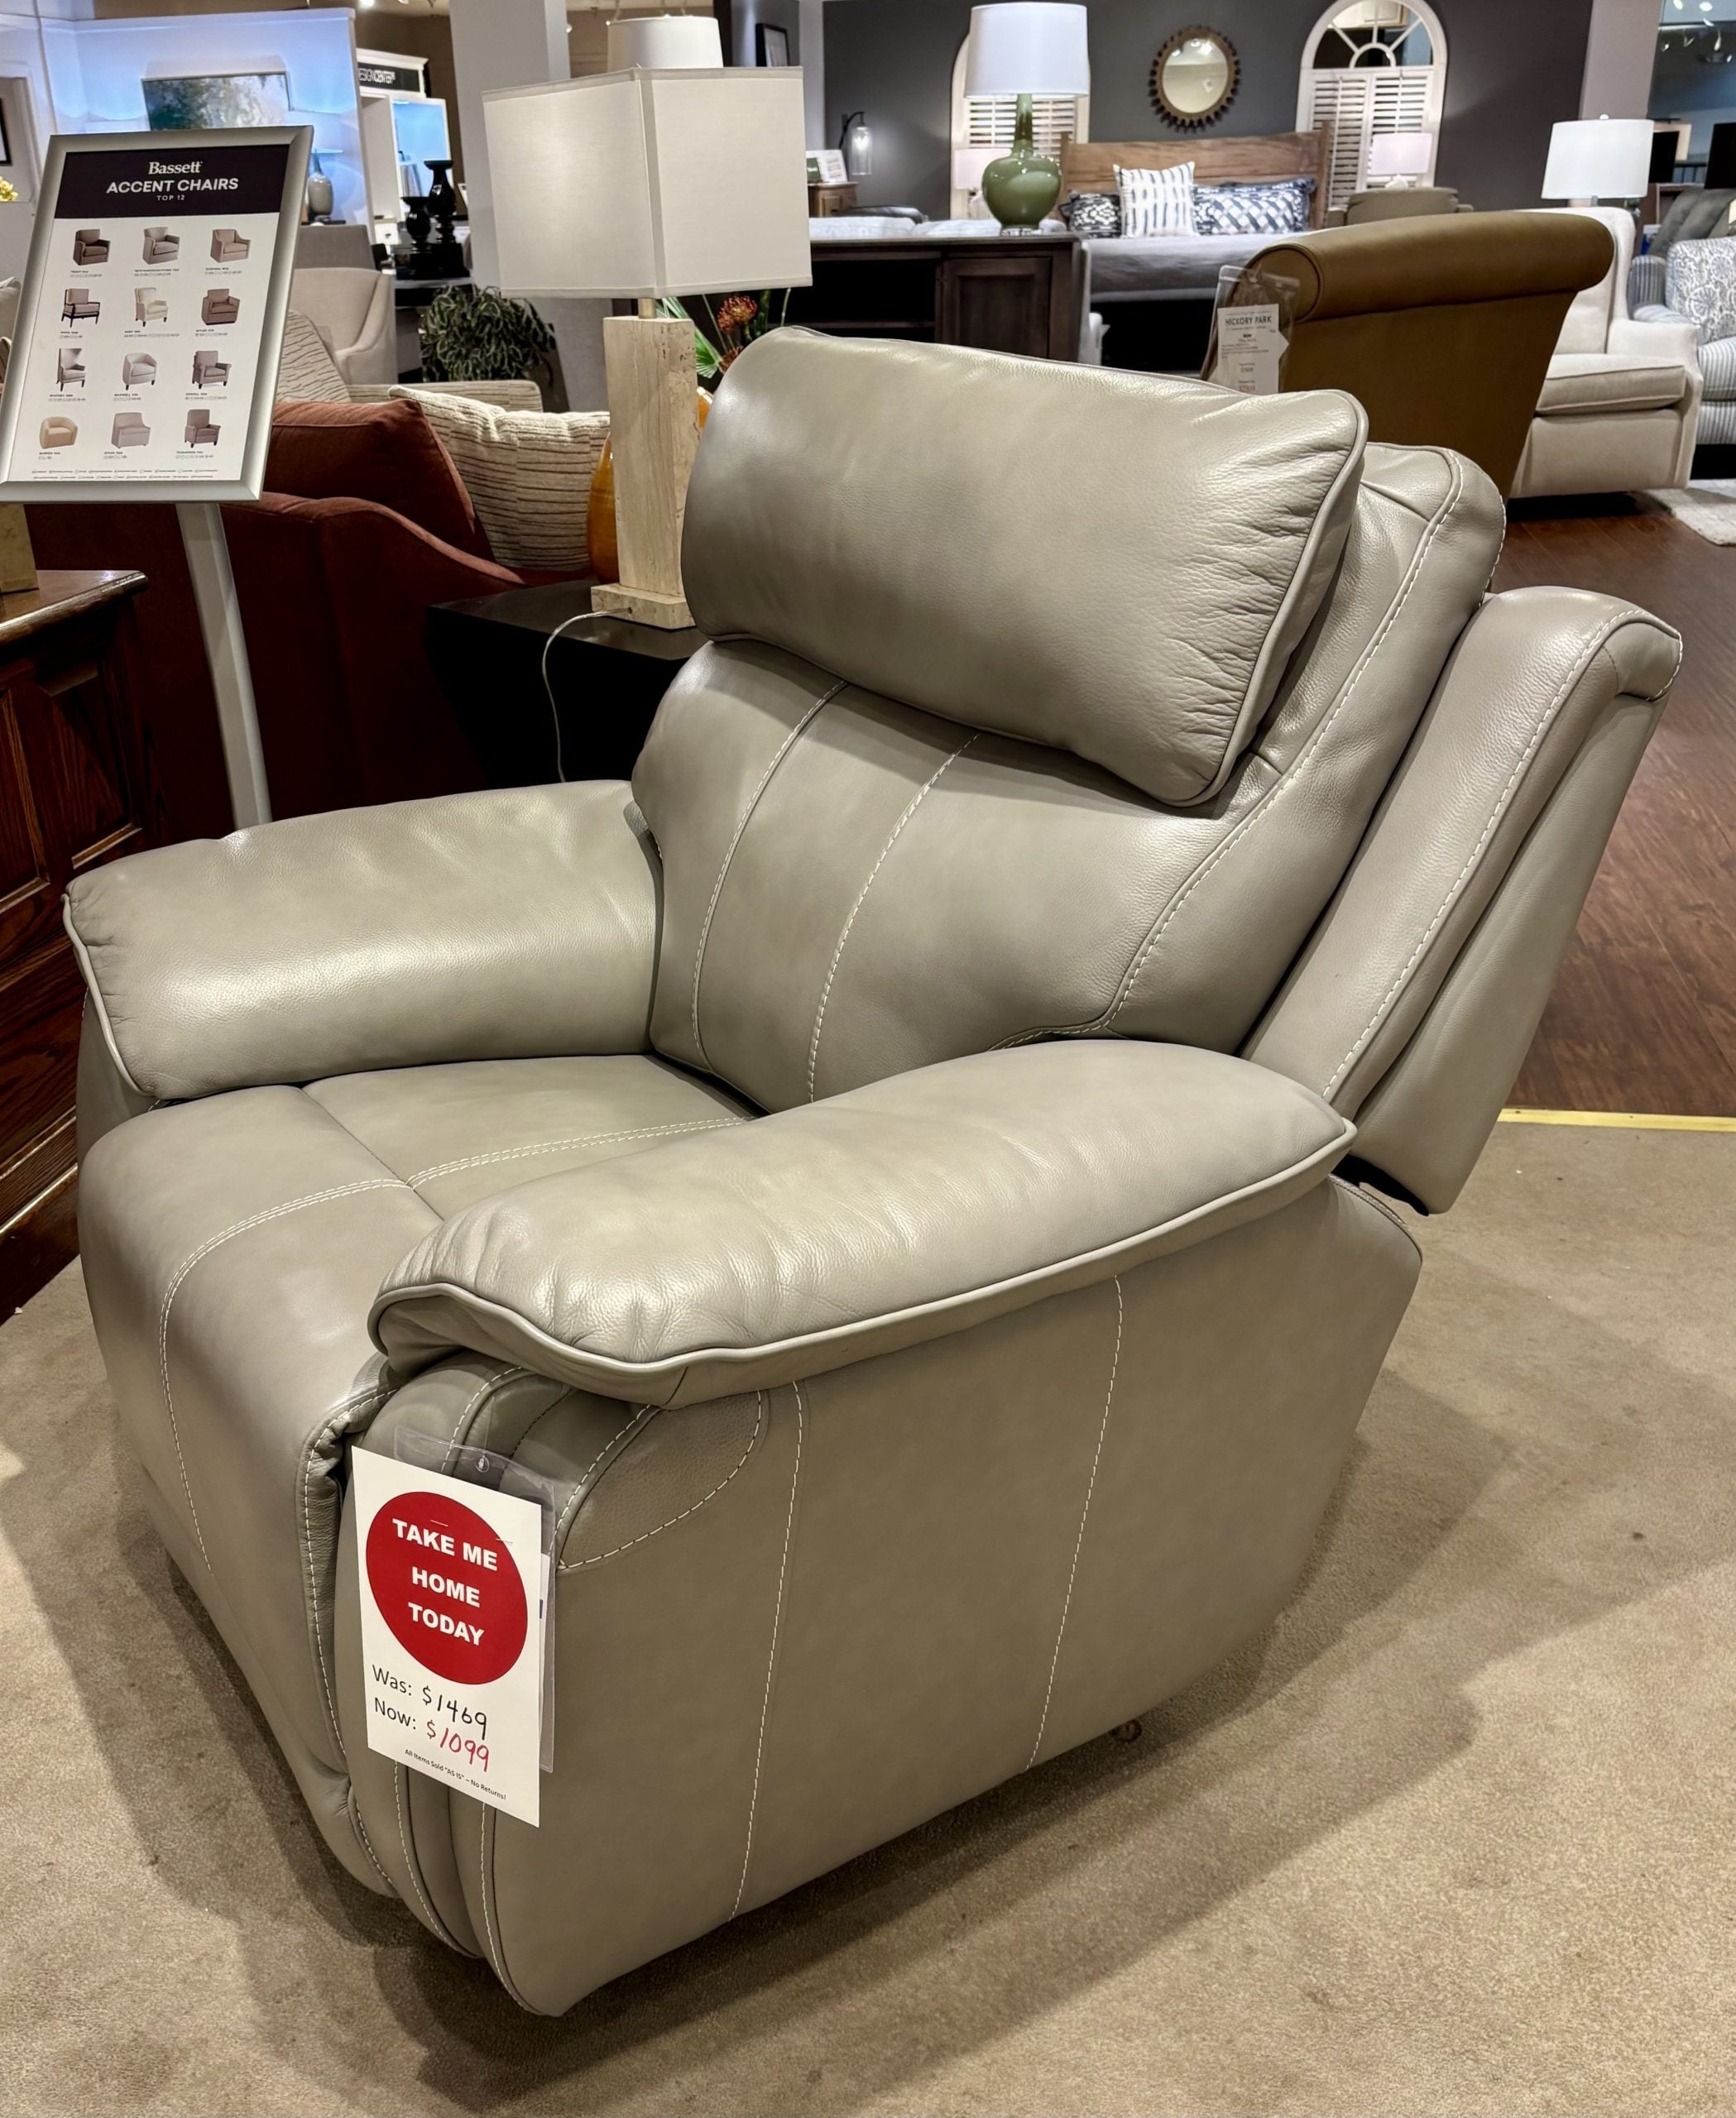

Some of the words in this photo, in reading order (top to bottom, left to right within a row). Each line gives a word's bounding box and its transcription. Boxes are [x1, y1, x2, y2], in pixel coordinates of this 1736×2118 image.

[106, 180, 175, 194] ACCENT
[177, 178, 238, 191] CHAIRS
[148, 161, 201, 175] Bassett
[1225, 317, 1253, 325] HICKORY
[1254, 315, 1272, 324] PARK
[392, 1518, 455, 1556] TAKE
[463, 1541, 497, 1571] ME
[411, 1566, 480, 1608] HOME
[408, 1602, 485, 1646] TODAY
[372, 1664, 412, 1696] Was:
[422, 1685, 487, 1741] $1469
[374, 1697, 416, 1730] Now:
[426, 1719, 490, 1773] $1099
[405, 1749, 413, 1757] All
[414, 1752, 430, 1766] Items
[430, 1761, 444, 1771] Sold
[470, 1780, 480, 1788] No
[481, 1784, 506, 1801] Returns!
